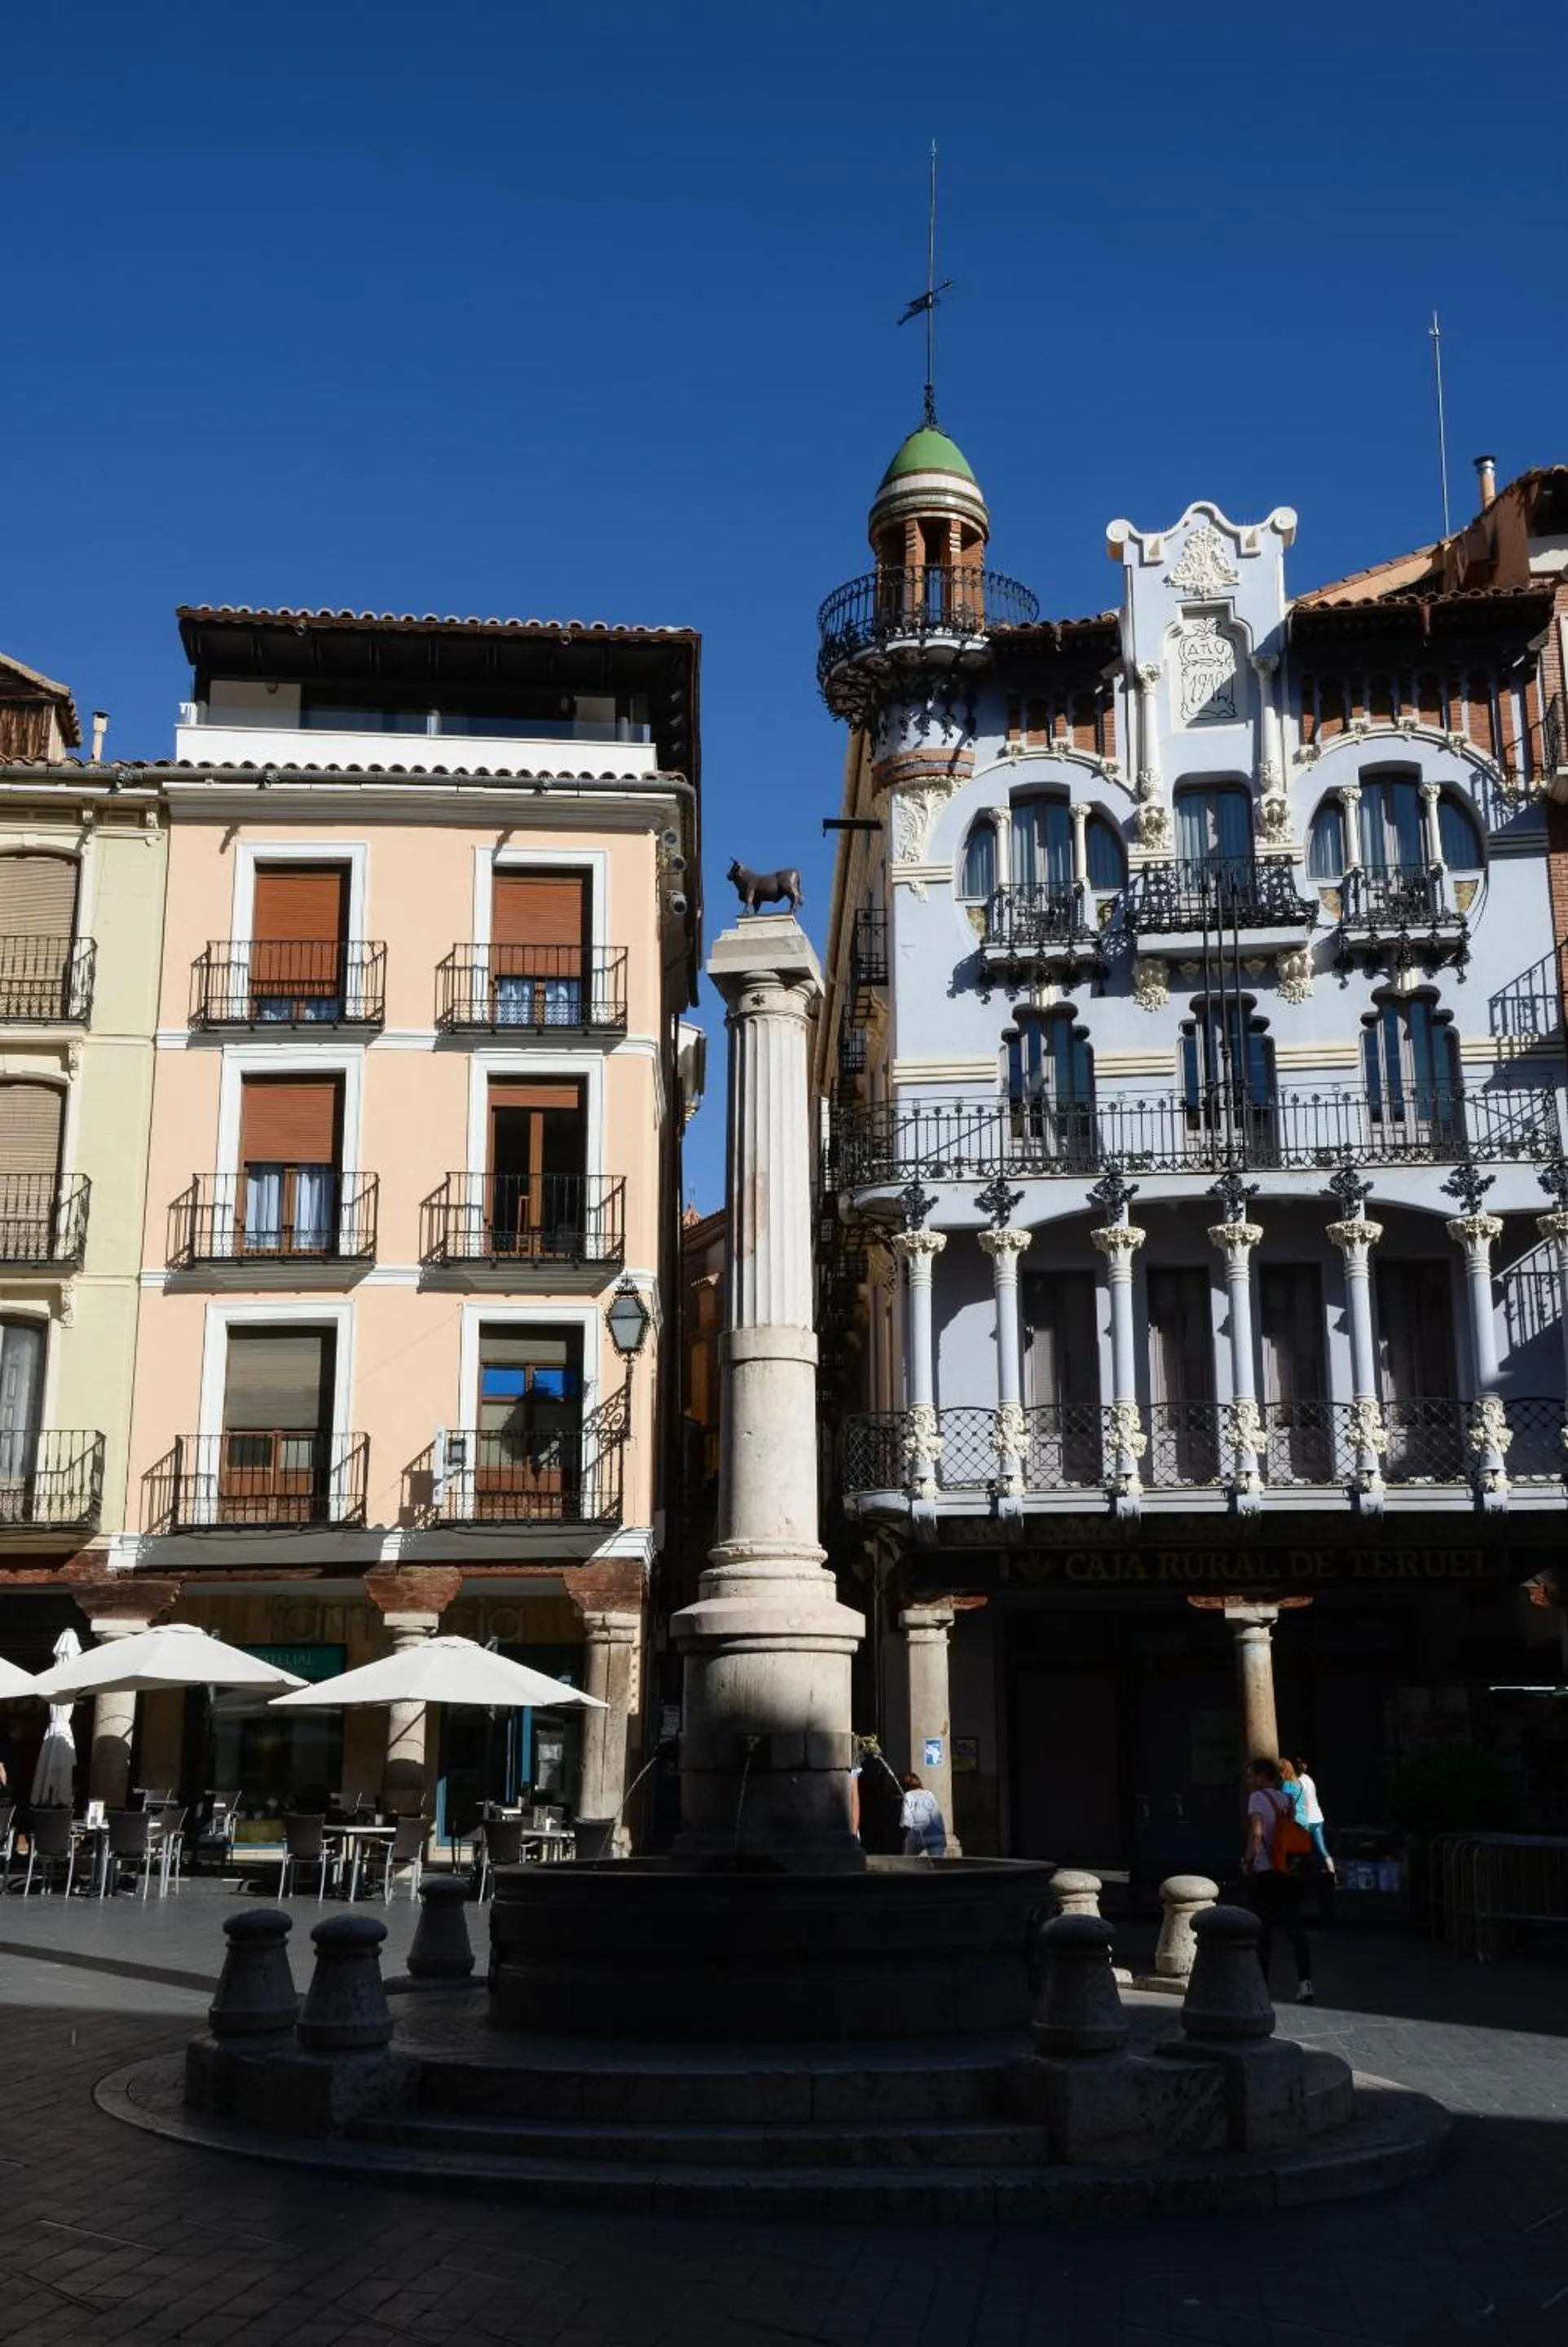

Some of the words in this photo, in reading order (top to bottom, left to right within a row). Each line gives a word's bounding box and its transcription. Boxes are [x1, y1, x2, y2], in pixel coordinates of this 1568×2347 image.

[1064, 1551, 1152, 1580] CAJA
[1157, 1550, 1280, 1579] RURAL
[1288, 1549, 1337, 1579] DE
[1347, 1549, 1497, 1579] TERUEL
